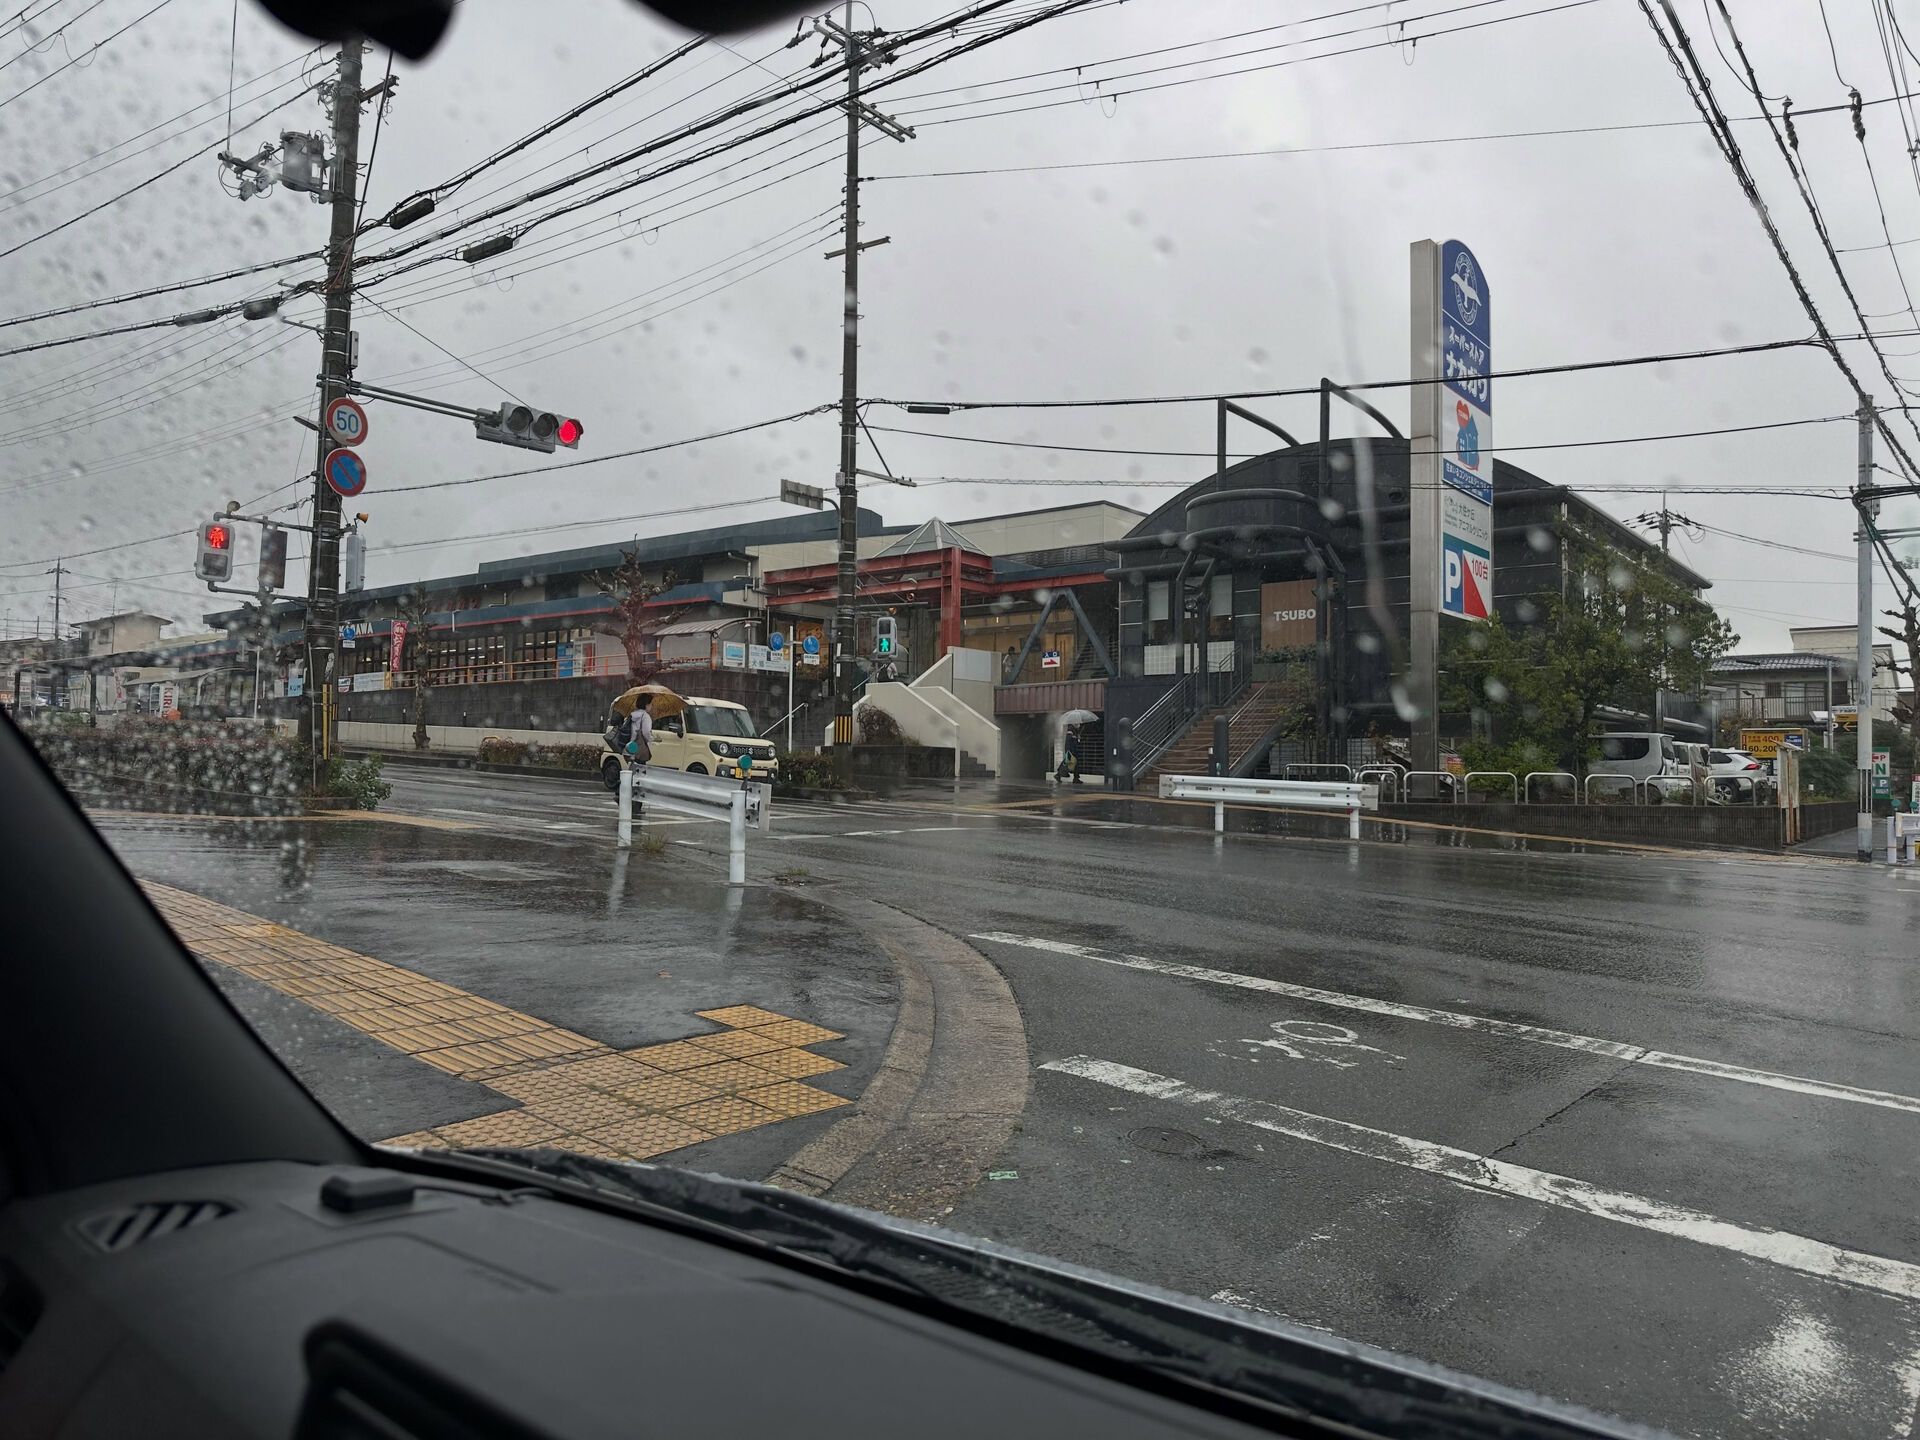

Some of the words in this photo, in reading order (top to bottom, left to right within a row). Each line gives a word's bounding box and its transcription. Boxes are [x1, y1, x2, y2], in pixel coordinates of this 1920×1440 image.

[1449, 325, 1485, 366] スーパーストア
[336, 409, 359, 434] 50
[1445, 549, 1461, 603] P
[1471, 557, 1489, 581] 100台
[1273, 608, 1317, 621] TSUBO
[1880, 779, 1887, 788] P
